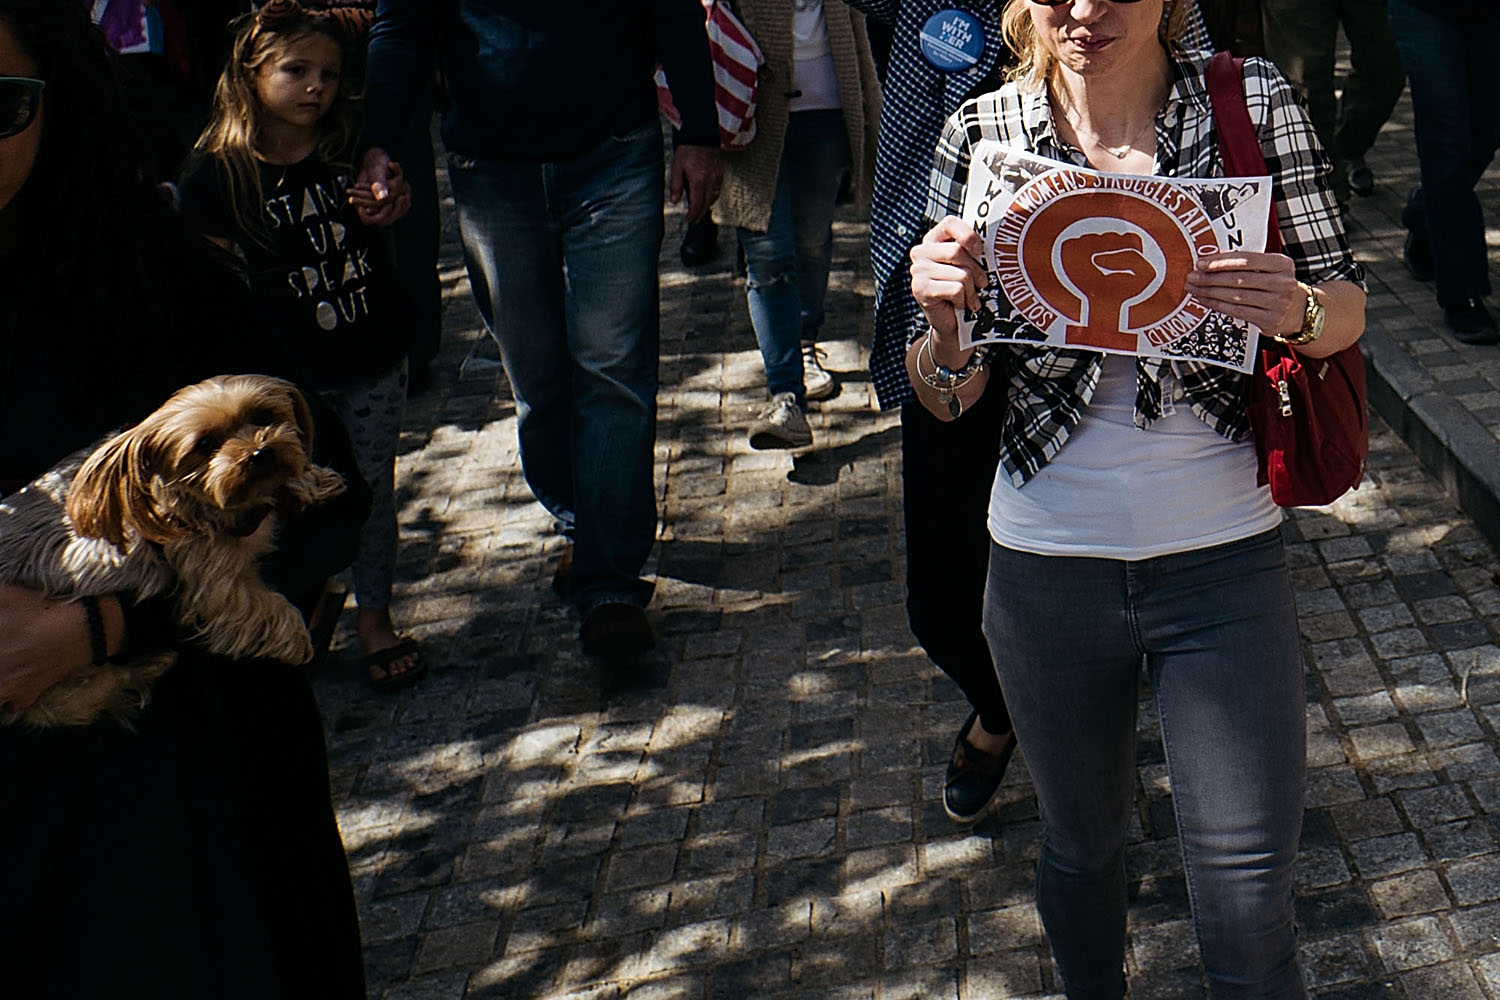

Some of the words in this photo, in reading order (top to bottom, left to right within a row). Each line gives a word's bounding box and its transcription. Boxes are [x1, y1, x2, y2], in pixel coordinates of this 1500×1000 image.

[941, 21, 973, 43] WITH
[1015, 170, 1087, 213] WOMENS
[1092, 173, 1186, 214] STRUGGLES
[996, 211, 1028, 247] WITH
[1178, 206, 1212, 243] ALL
[287, 247, 373, 298] SPEAK
[996, 246, 1054, 331] SOLIDARITY
[315, 285, 369, 331] OUT
[1147, 309, 1202, 346] WORLD
